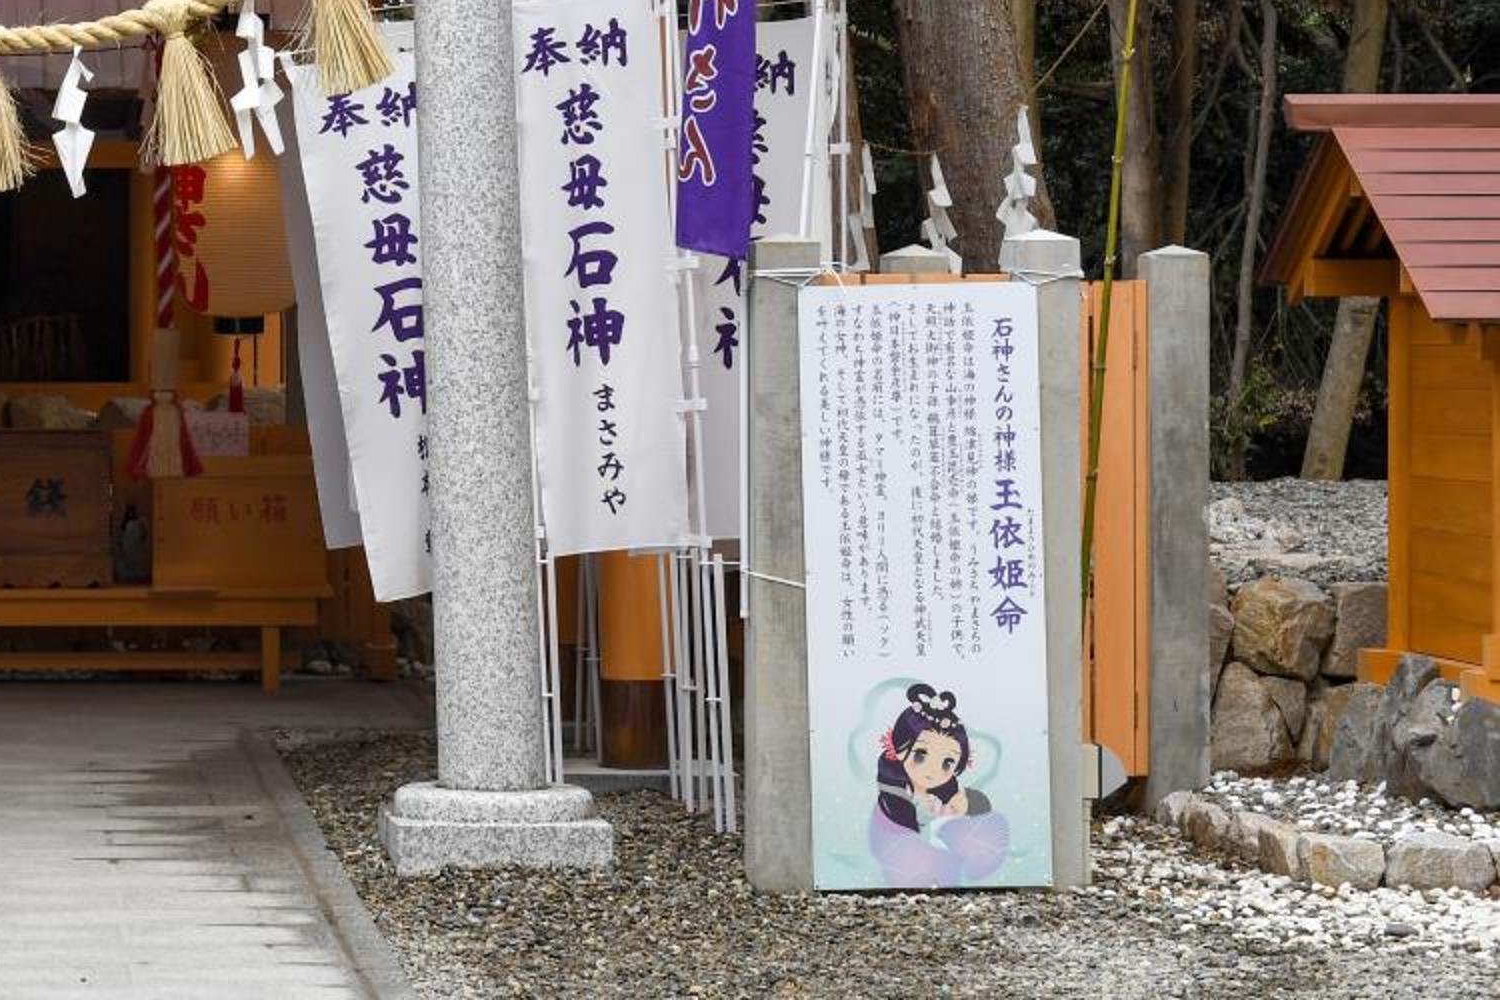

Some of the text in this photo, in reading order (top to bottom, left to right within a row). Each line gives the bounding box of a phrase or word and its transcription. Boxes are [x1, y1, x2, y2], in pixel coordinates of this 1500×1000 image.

[318, 81, 417, 138] 奉納
[521, 17, 629, 77] 奉納
[355, 143, 427, 419] 慈母石神
[555, 83, 626, 367] 慈母石神
[593, 382, 627, 516] まさみや
